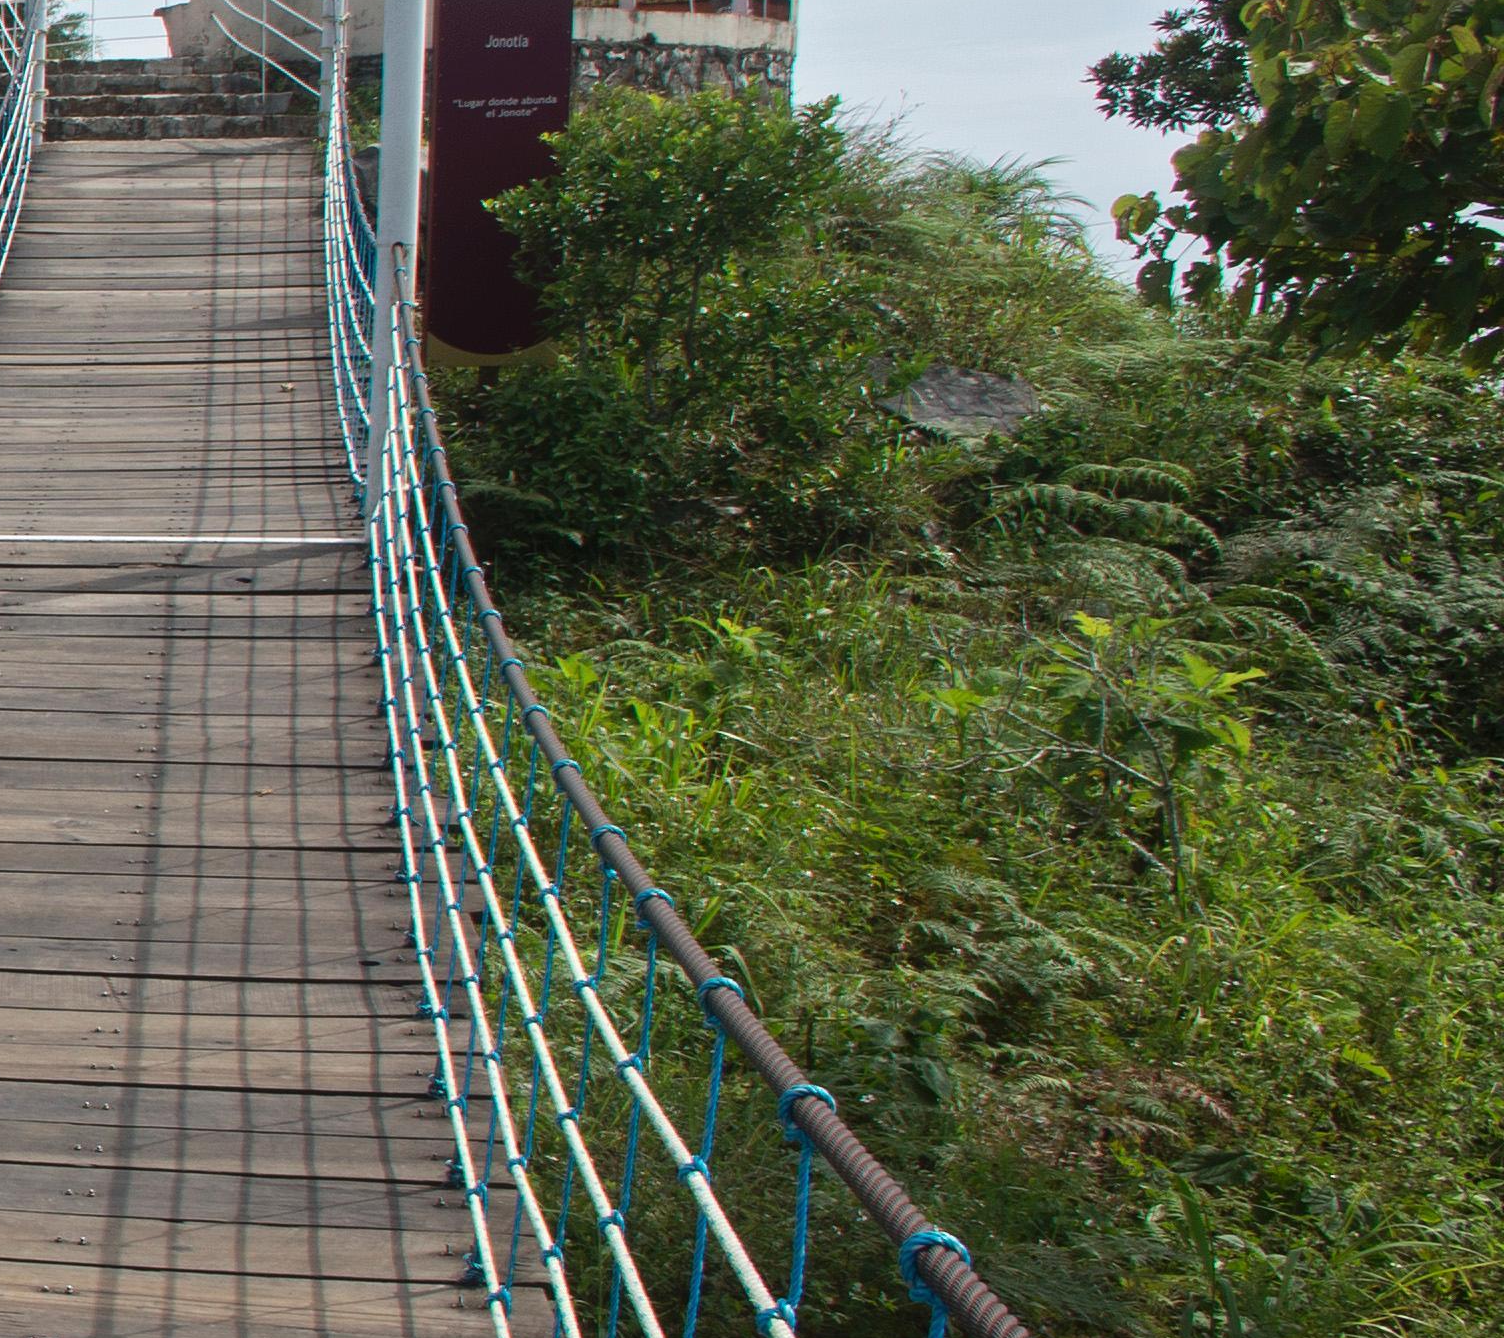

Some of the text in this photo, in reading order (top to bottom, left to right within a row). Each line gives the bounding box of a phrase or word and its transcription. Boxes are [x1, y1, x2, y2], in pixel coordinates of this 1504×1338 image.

[488, 97, 519, 107] donde
[521, 94, 557, 105] abunda
[485, 108, 495, 118] el
